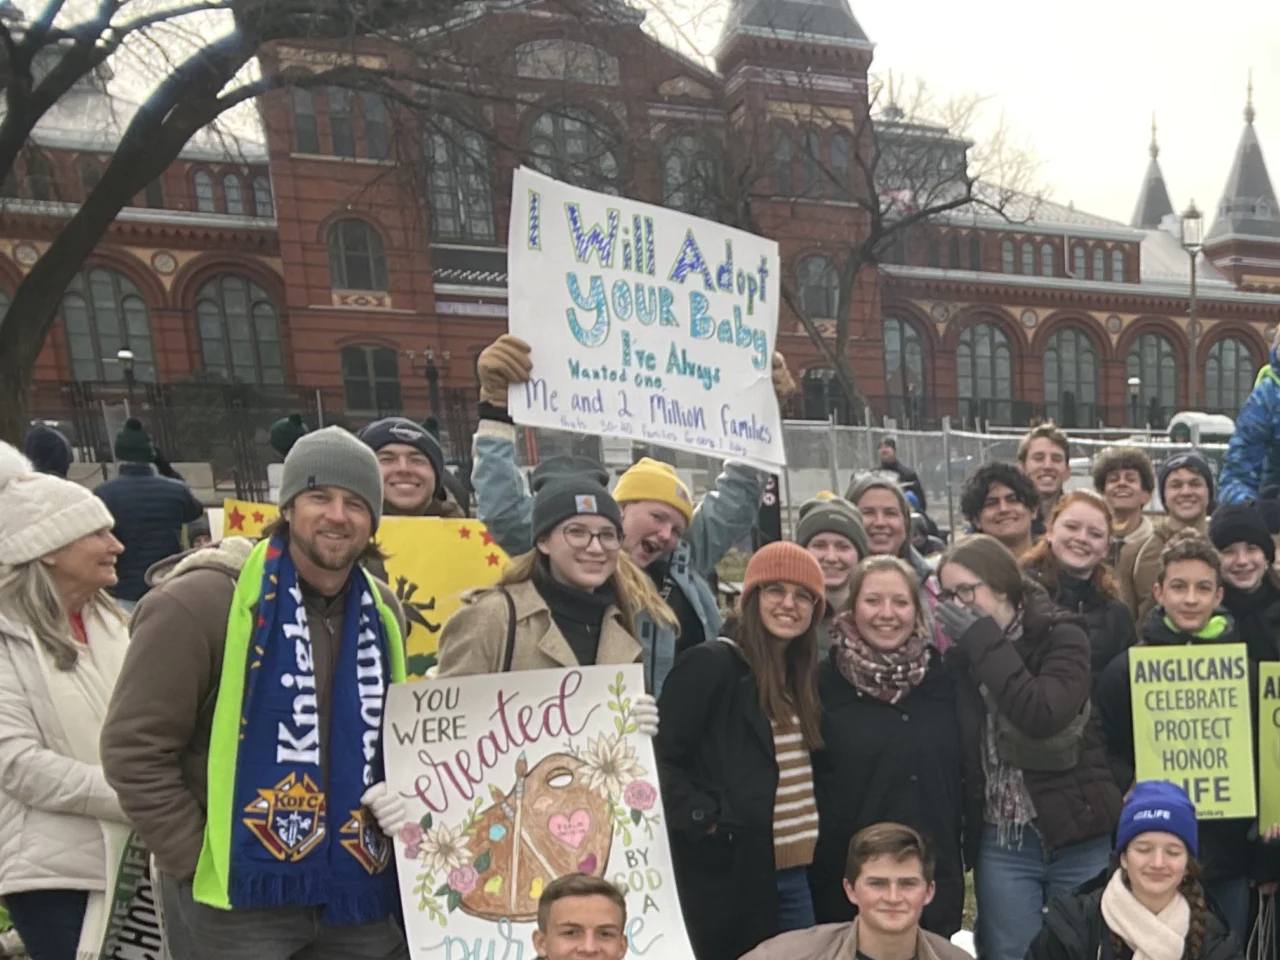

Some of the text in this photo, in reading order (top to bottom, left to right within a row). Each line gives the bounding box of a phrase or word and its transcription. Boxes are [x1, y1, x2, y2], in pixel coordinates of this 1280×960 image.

[528, 189, 769, 315] I Will Adopt
[689, 290, 768, 370] Baby
[568, 357, 627, 383] Wanted
[621, 330, 721, 391] I've Always
[524, 377, 558, 412] Me
[571, 389, 604, 415] and
[617, 389, 633, 418] 2
[1134, 656, 1245, 684] ANGLICANS
[412, 686, 460, 713] YOU
[1145, 687, 1238, 711] CELEBRATE
[391, 714, 468, 746] WERE
[399, 669, 602, 813] created
[1154, 717, 1232, 741] PROTECT
[1162, 748, 1229, 771] HONOR
[1182, 776, 1232, 803] IFE
[624, 847, 650, 869] BY
[614, 869, 663, 893] GOD
[642, 894, 660, 915] A
